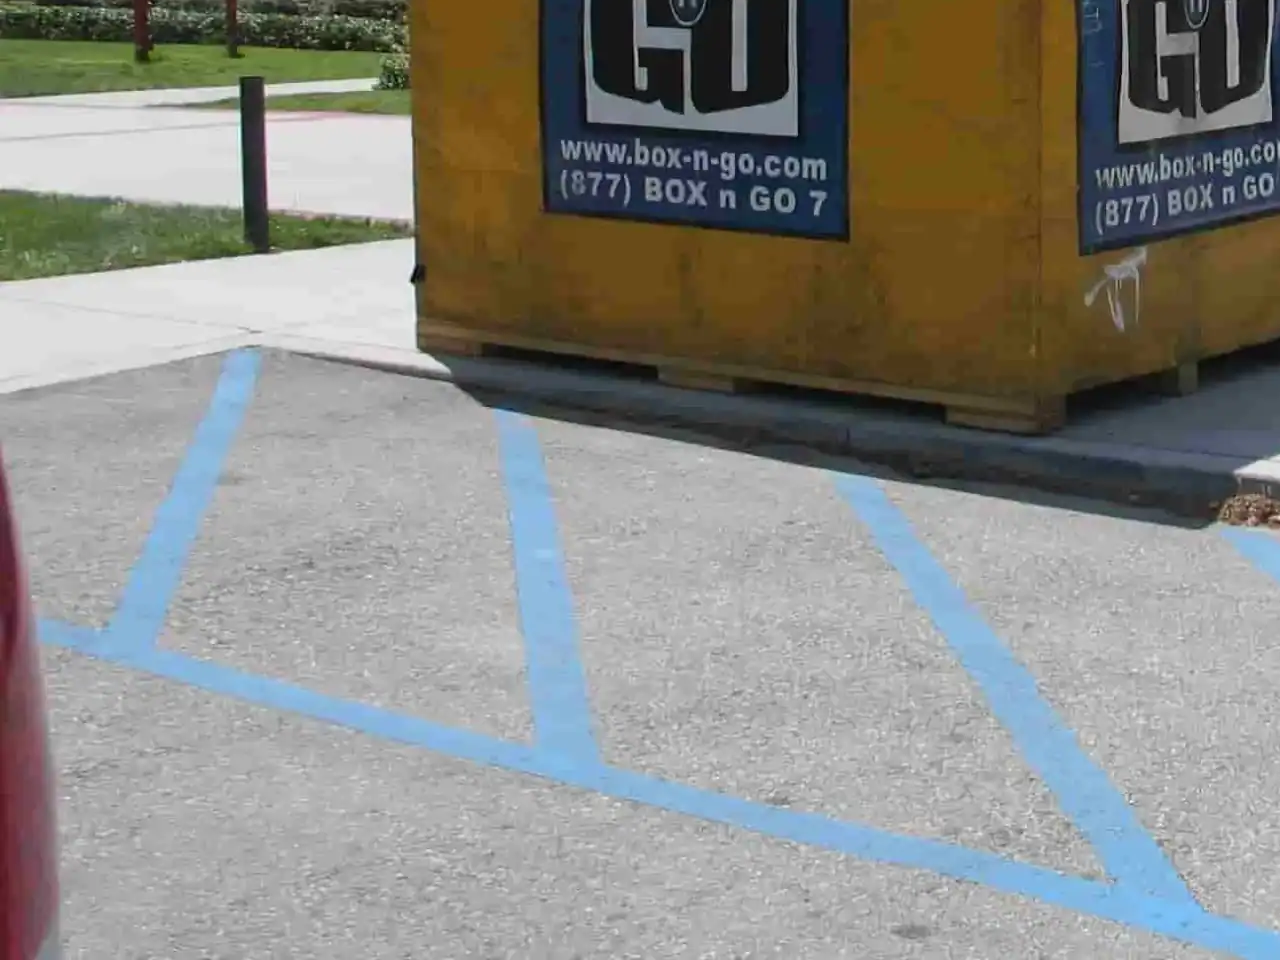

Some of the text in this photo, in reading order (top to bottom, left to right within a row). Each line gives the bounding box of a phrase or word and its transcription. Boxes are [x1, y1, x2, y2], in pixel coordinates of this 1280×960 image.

[560, 138, 827, 180] www.box-n-go.com
[560, 170, 828, 217] (877) BOX n GO 7
[1095, 193, 1159, 235] (877)
[1168, 183, 1213, 216] BOX
[1222, 185, 1235, 205] n
[1243, 172, 1274, 200] GO
